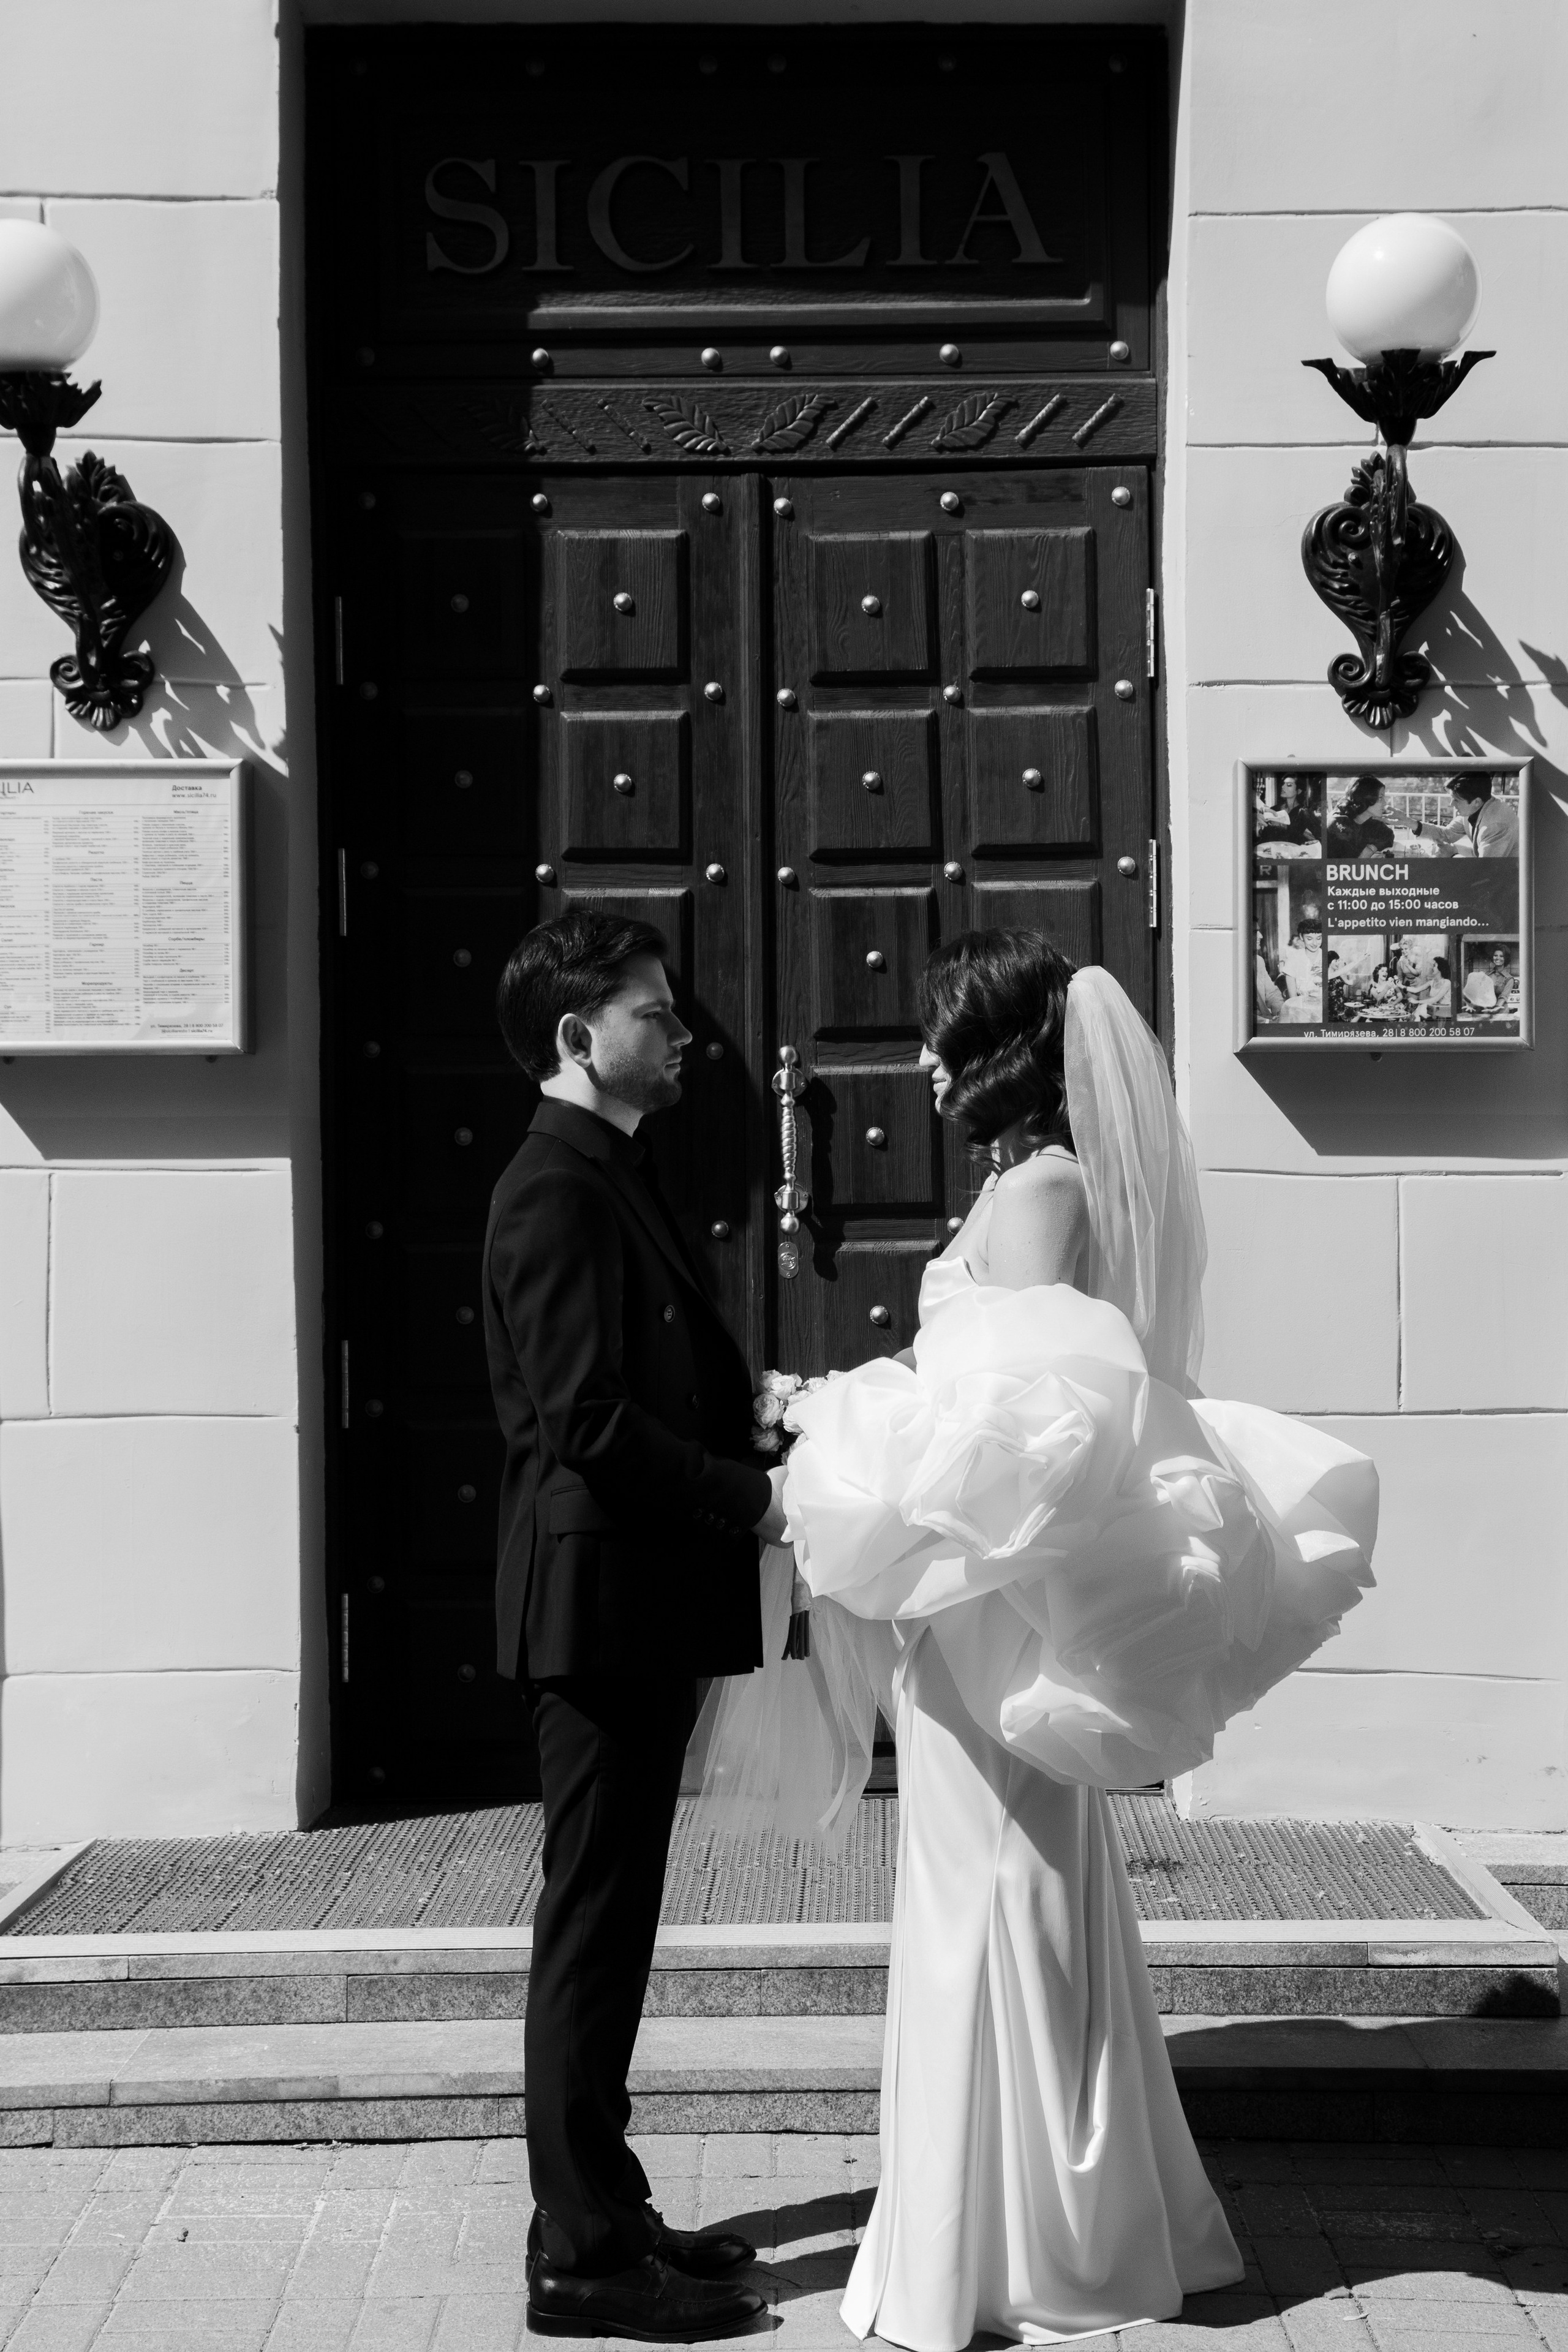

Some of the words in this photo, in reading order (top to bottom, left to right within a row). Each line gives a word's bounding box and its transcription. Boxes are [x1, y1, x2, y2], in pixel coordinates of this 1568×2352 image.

[424, 151, 1064, 274] SICILIA
[1326, 864, 1409, 881] BRUNCH
[1327, 886, 1376, 897] Каждые
[1379, 887, 1440, 897] выходные
[1338, 900, 1367, 910] 11:00
[1371, 902, 1385, 911] до
[1389, 899, 1421, 910] 15:00
[1327, 917, 1387, 930] L'appetito
[1389, 917, 1413, 927] vien
[1415, 916, 1490, 929] mangiando...
[1382, 1028, 1394, 1037] 28
[1429, 1028, 1447, 1036] 200
